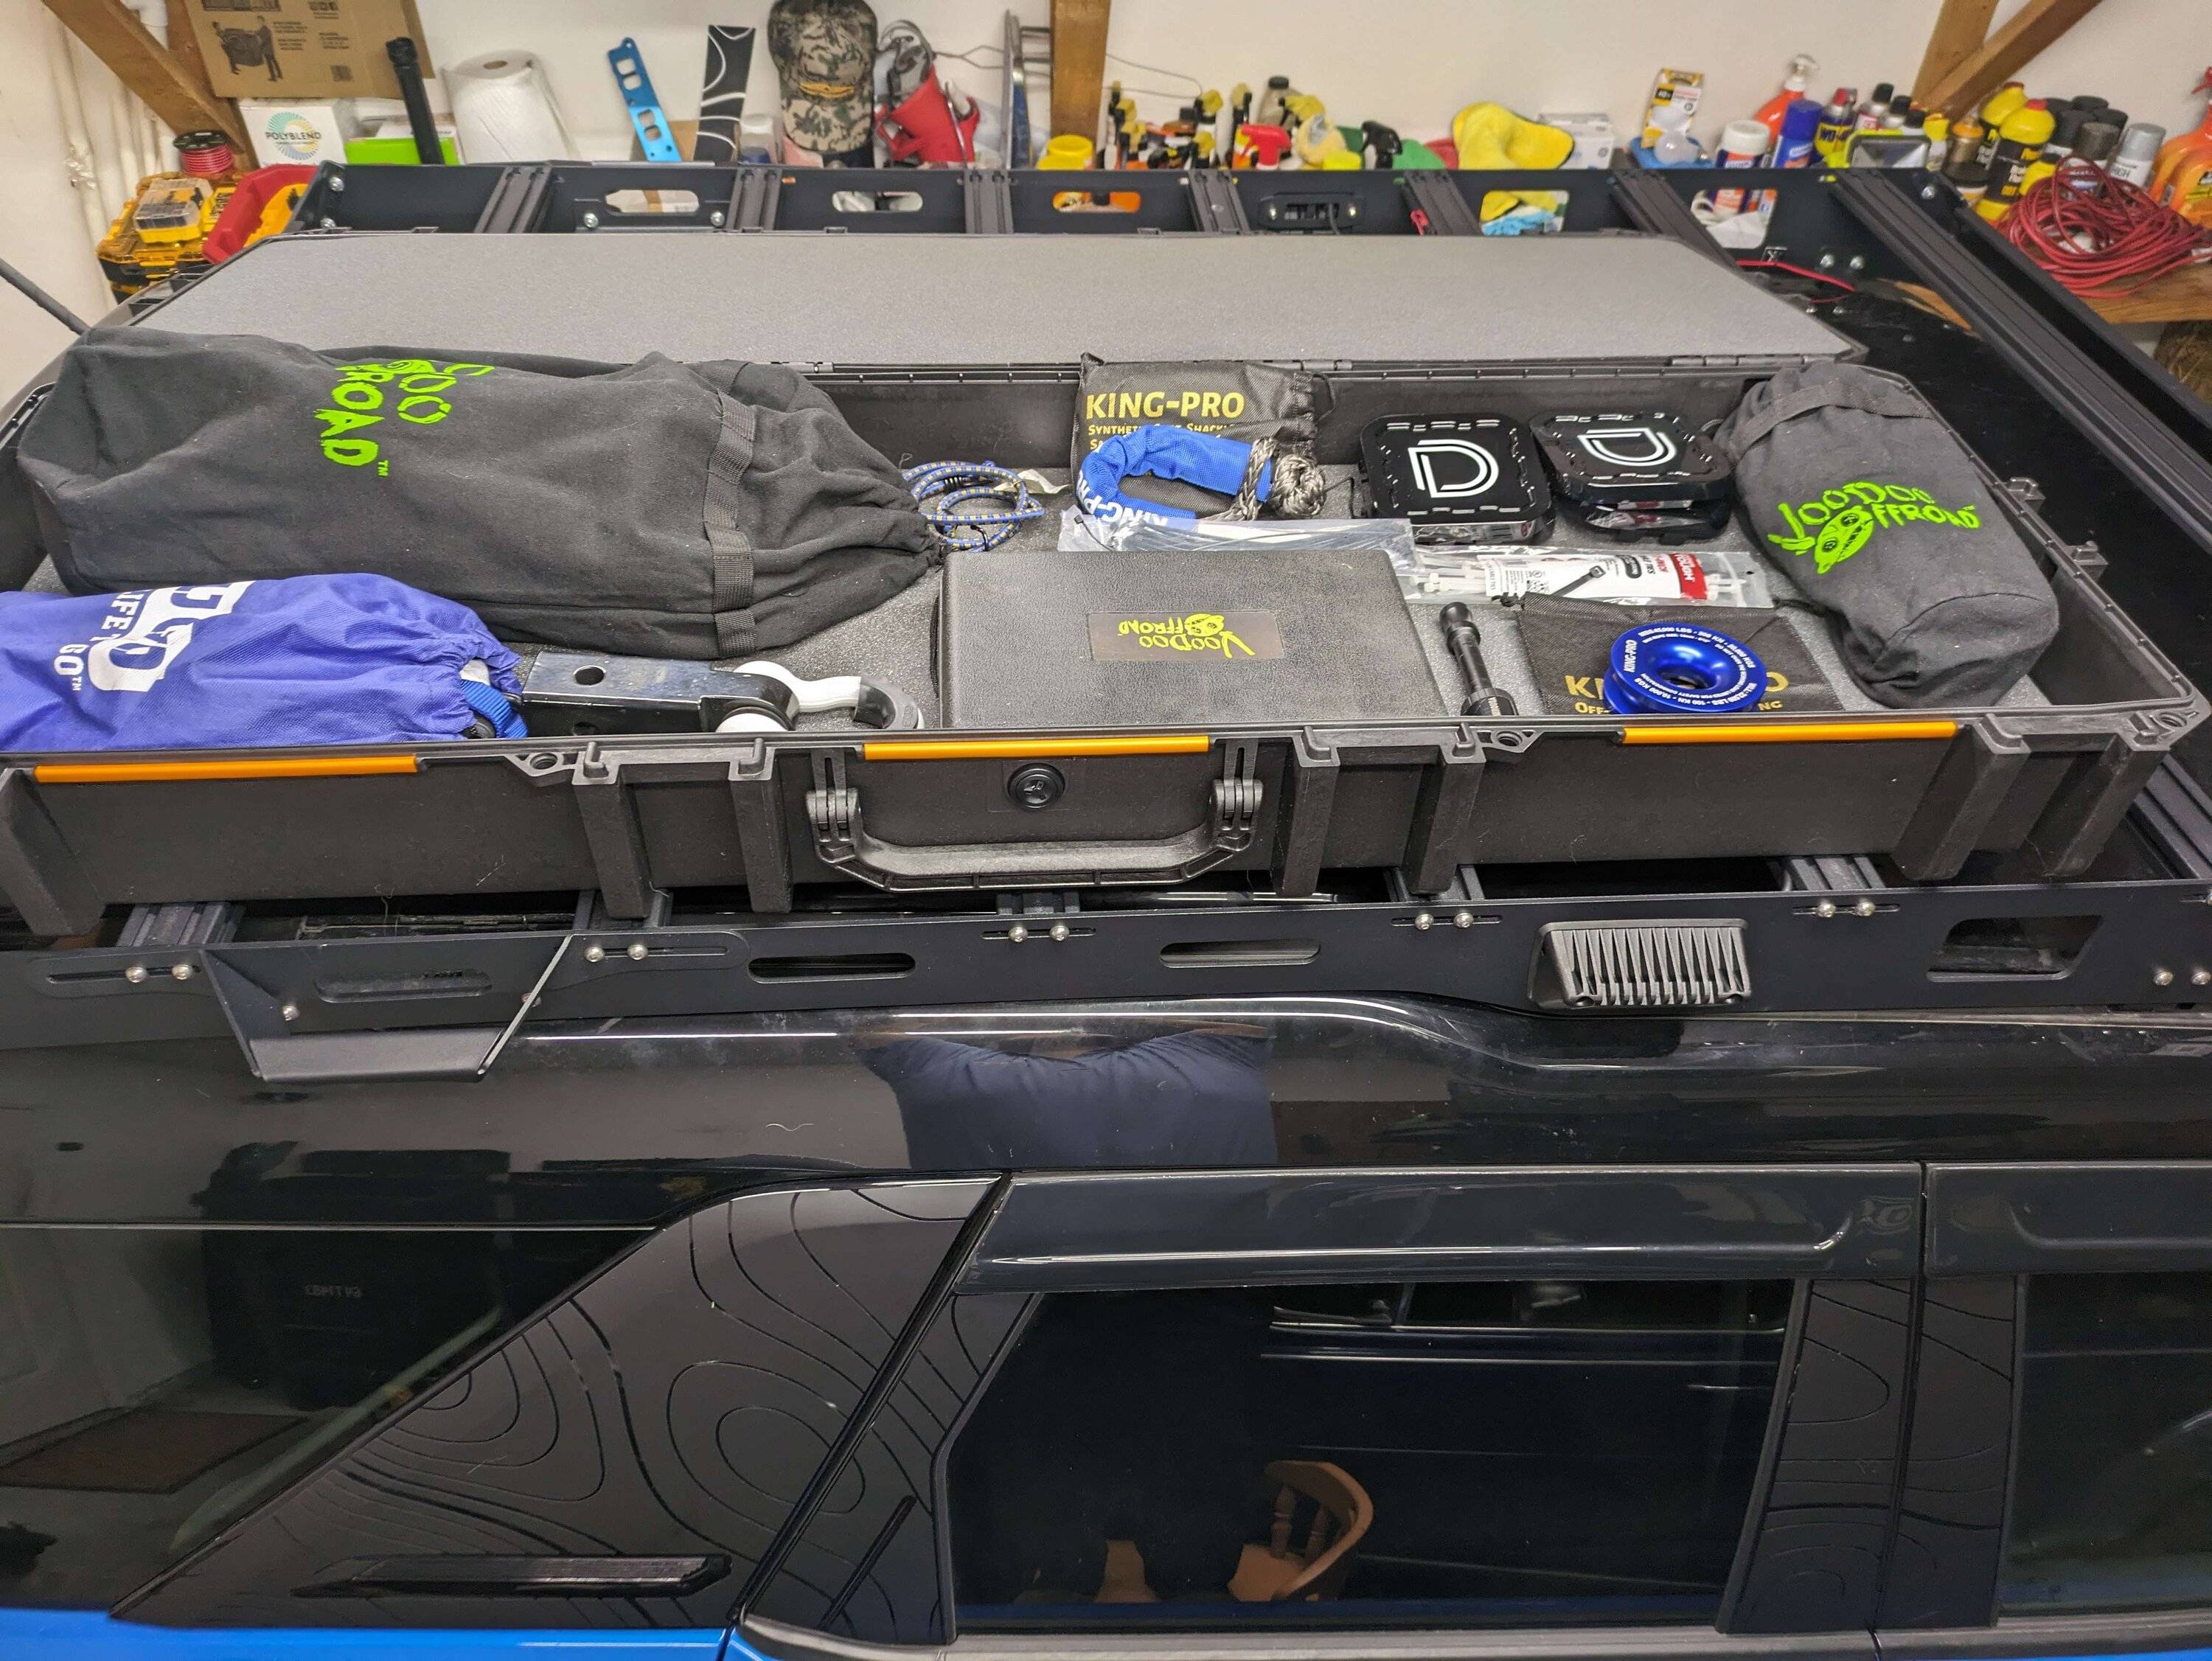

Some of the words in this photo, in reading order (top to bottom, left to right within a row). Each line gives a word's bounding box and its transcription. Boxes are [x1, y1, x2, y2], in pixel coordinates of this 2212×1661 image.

[265, 131, 322, 141] POLYBLEND
[1086, 391, 1245, 420] KING-PRO
[1623, 639, 1638, 672] KING-PRO
[1710, 697, 1730, 706] LBS
